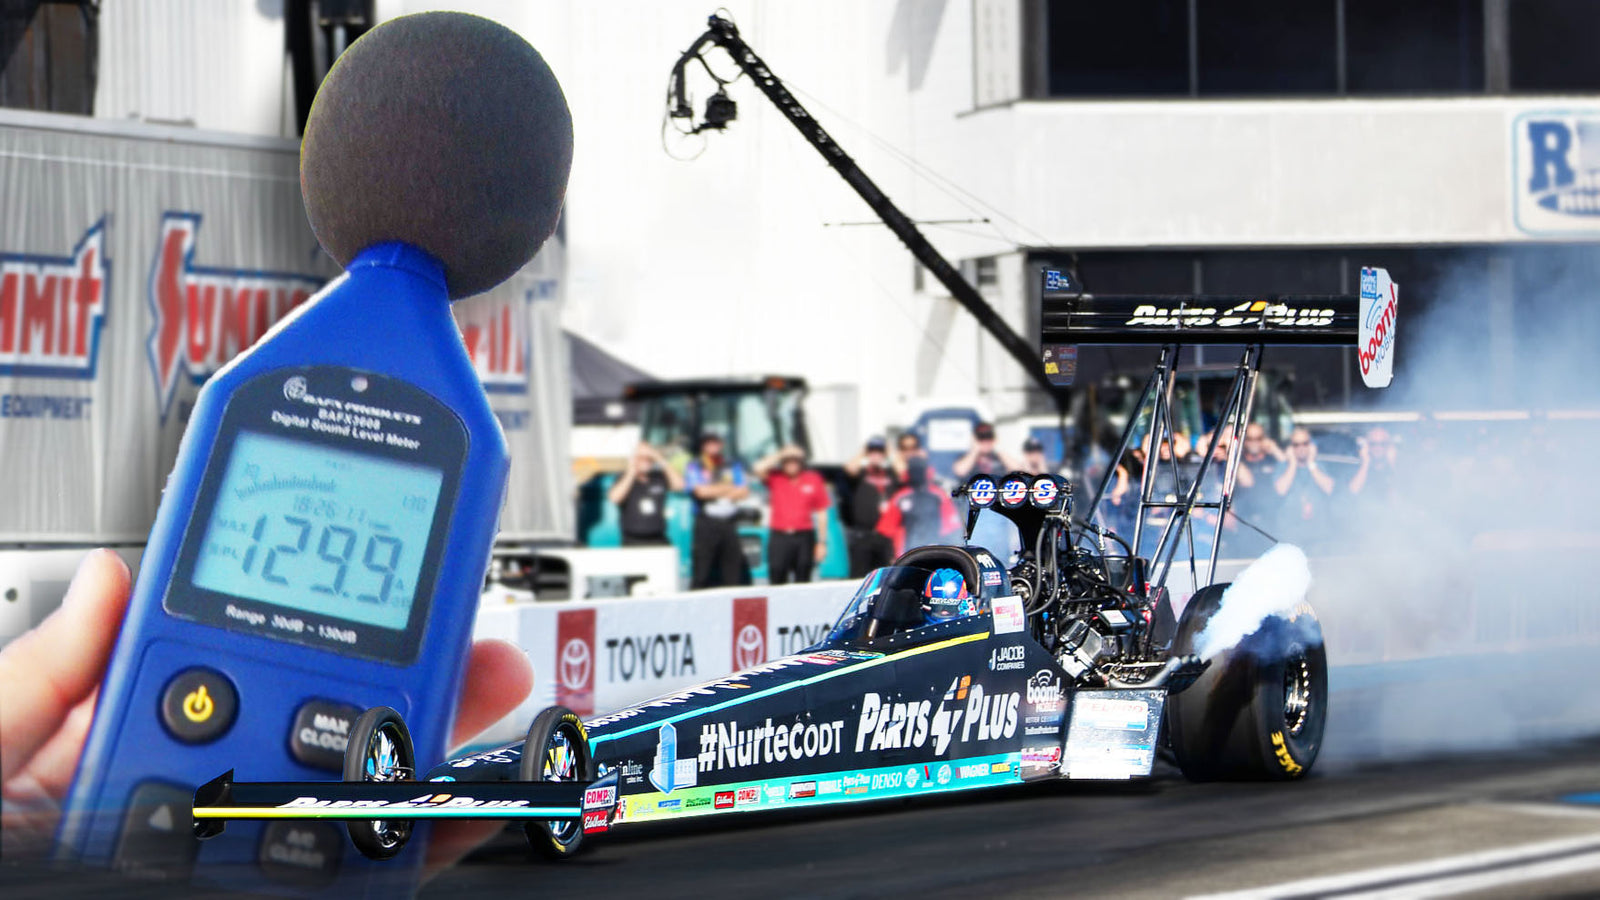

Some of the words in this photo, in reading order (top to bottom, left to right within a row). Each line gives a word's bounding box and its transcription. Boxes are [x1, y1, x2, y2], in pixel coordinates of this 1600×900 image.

[271, 410, 310, 428] Digital
[311, 418, 351, 437] Sound
[351, 427, 384, 443] Level
[385, 433, 421, 450] Meter
[242, 513, 404, 604] 129.9
[225, 604, 266, 625] Range
[777, 623, 832, 656] TOY
[605, 632, 696, 683] TOYOTA
[997, 645, 1025, 662] JACOB
[997, 661, 1025, 671] COMPANIES
[314, 713, 350, 735] MAX
[855, 692, 932, 753] PARTS
[961, 683, 1021, 743] PLUS
[871, 772, 903, 790] DENSO
[586, 789, 609, 805] COMP
